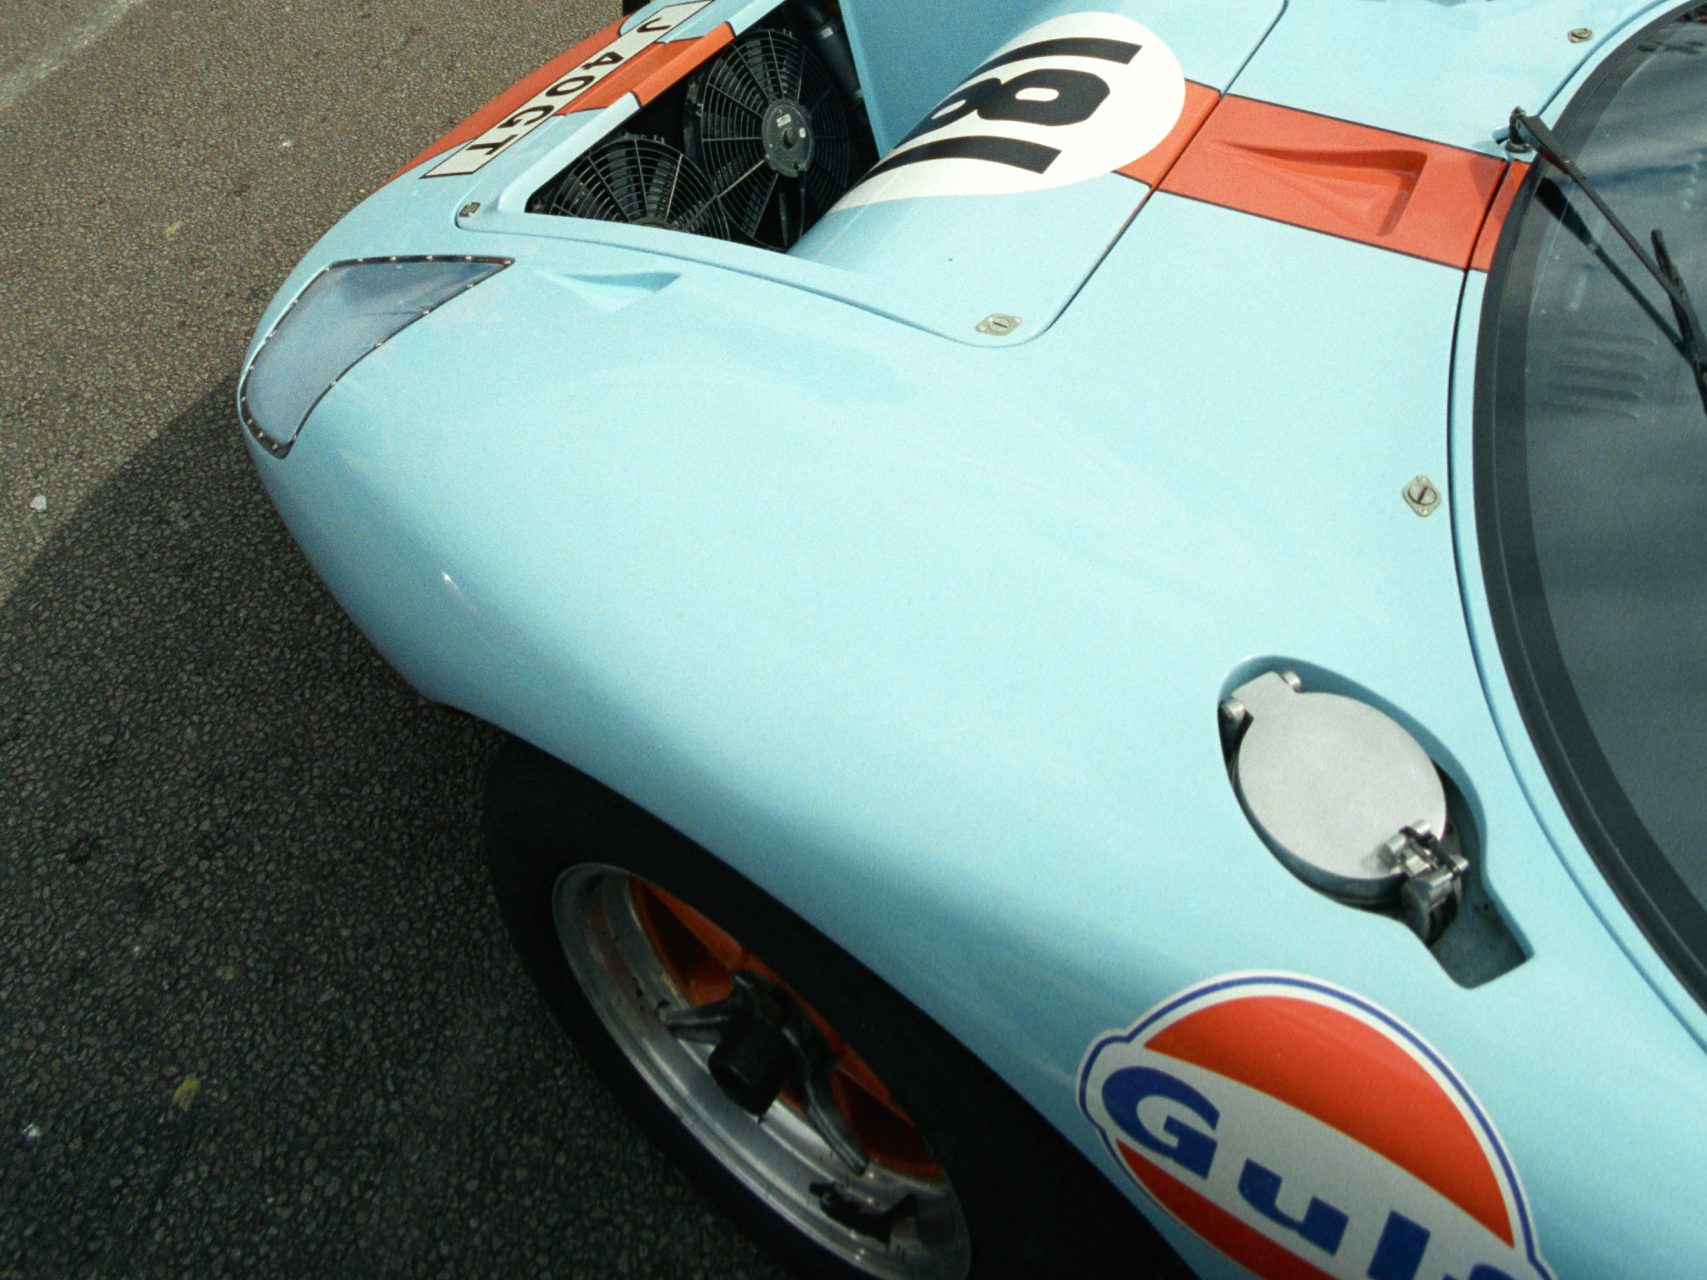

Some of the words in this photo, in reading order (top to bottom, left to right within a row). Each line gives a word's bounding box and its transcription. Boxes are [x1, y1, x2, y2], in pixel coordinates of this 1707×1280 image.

[636, 18, 671, 34] J
[466, 51, 624, 156] 40GT
[850, 37, 1143, 190] 181
